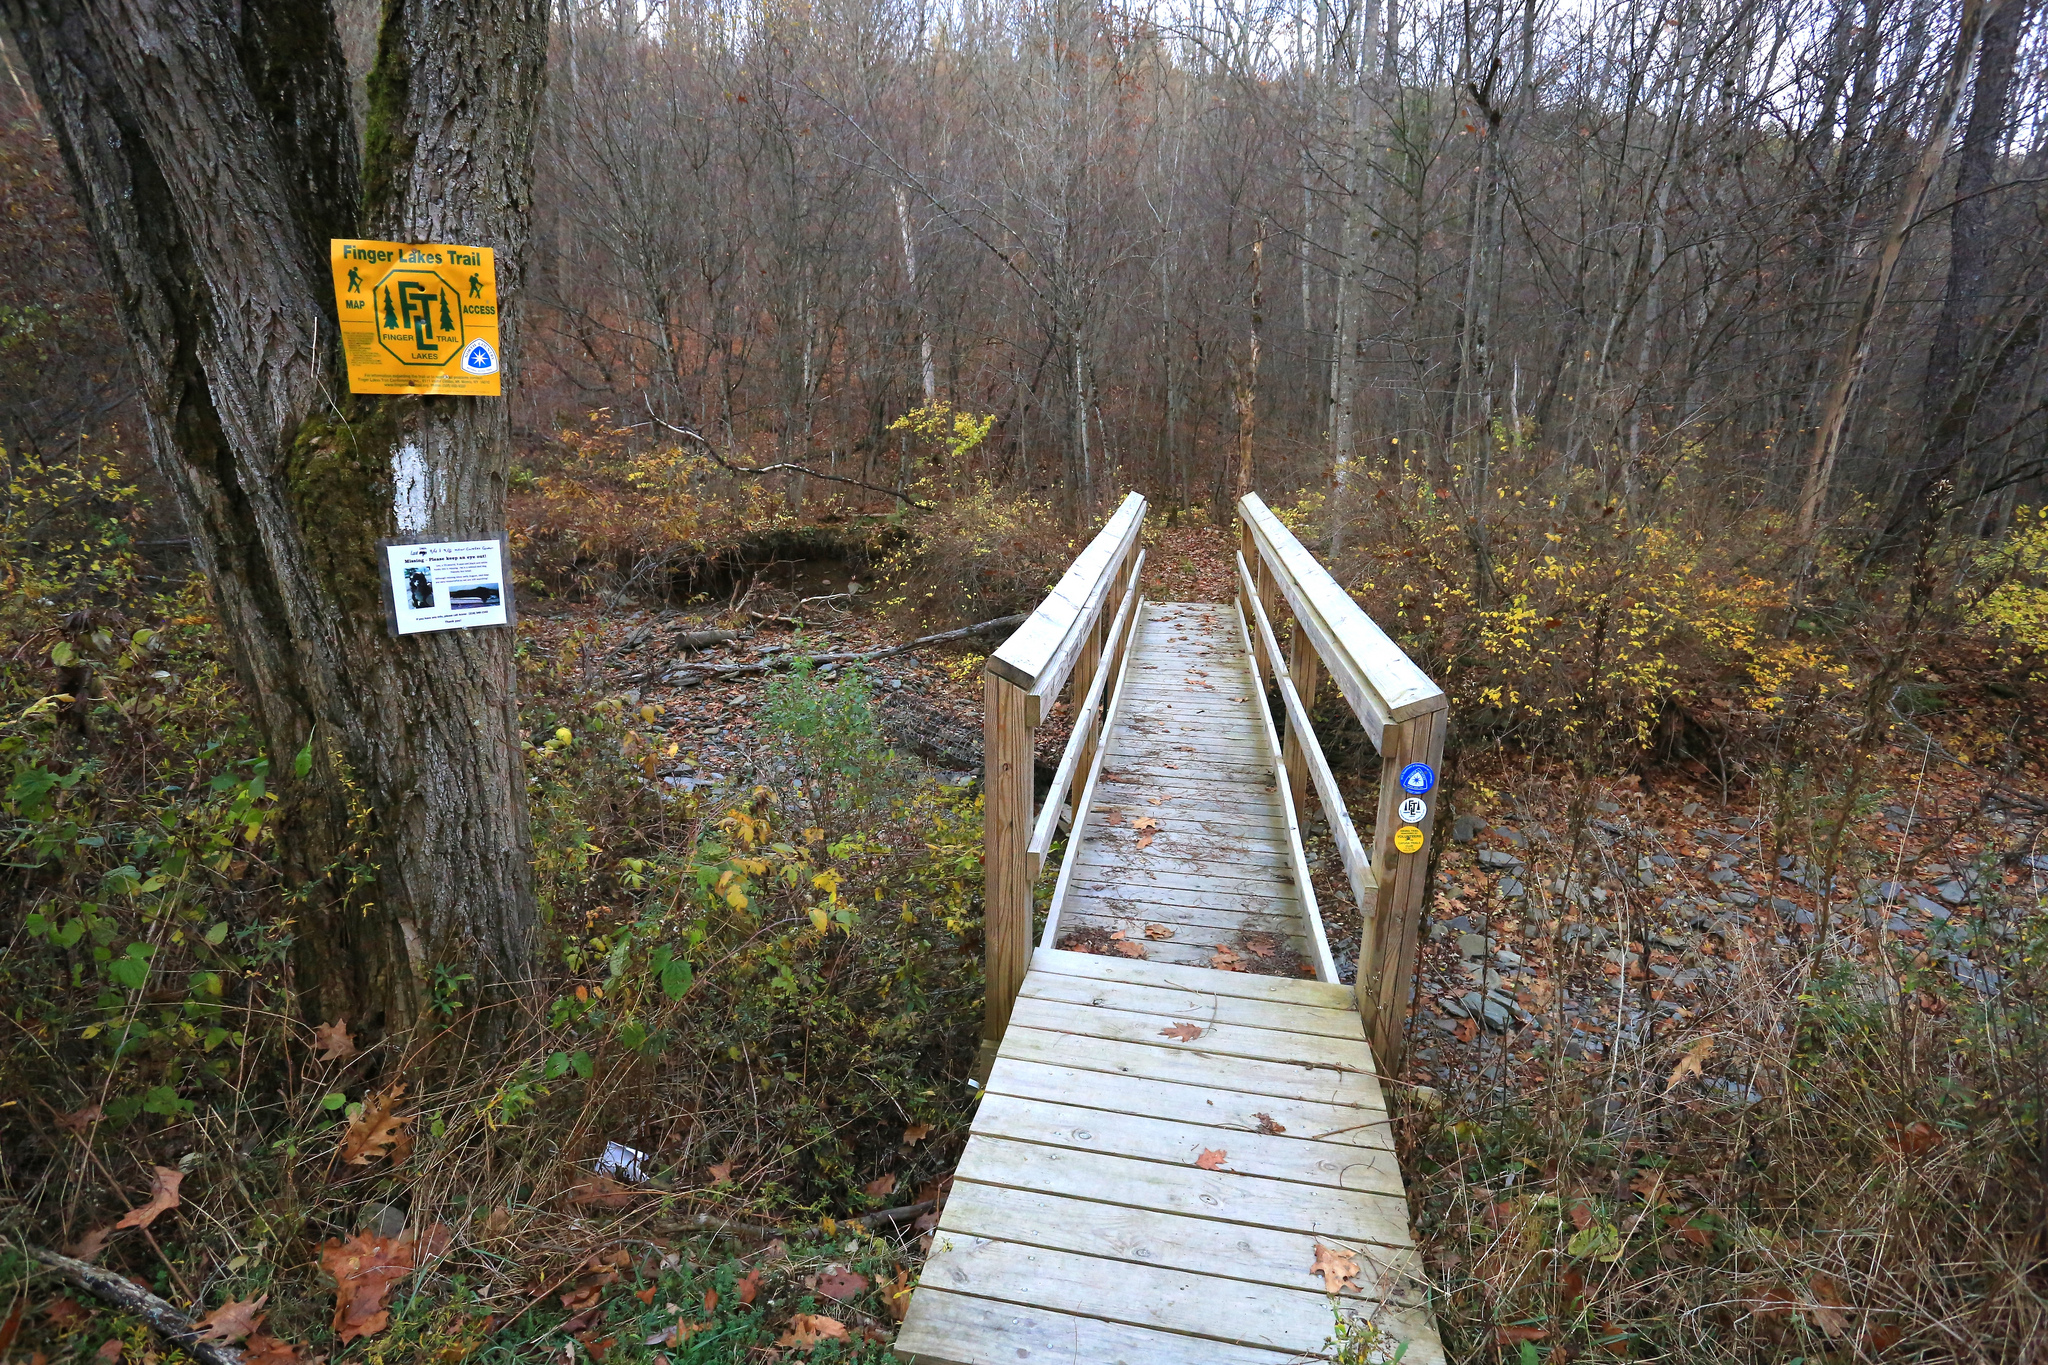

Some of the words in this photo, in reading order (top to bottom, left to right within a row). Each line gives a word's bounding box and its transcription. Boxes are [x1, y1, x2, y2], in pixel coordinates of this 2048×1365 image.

[343, 245, 393, 264] Finger
[398, 249, 443, 264] Lakes
[447, 250, 481, 266] Trail
[345, 300, 365, 309] MAP
[463, 305, 495, 314] ACCESS
[436, 335, 459, 343] TRAIL
[464, 344, 477, 358] NORTH
[478, 342, 495, 360] COUNTRY
